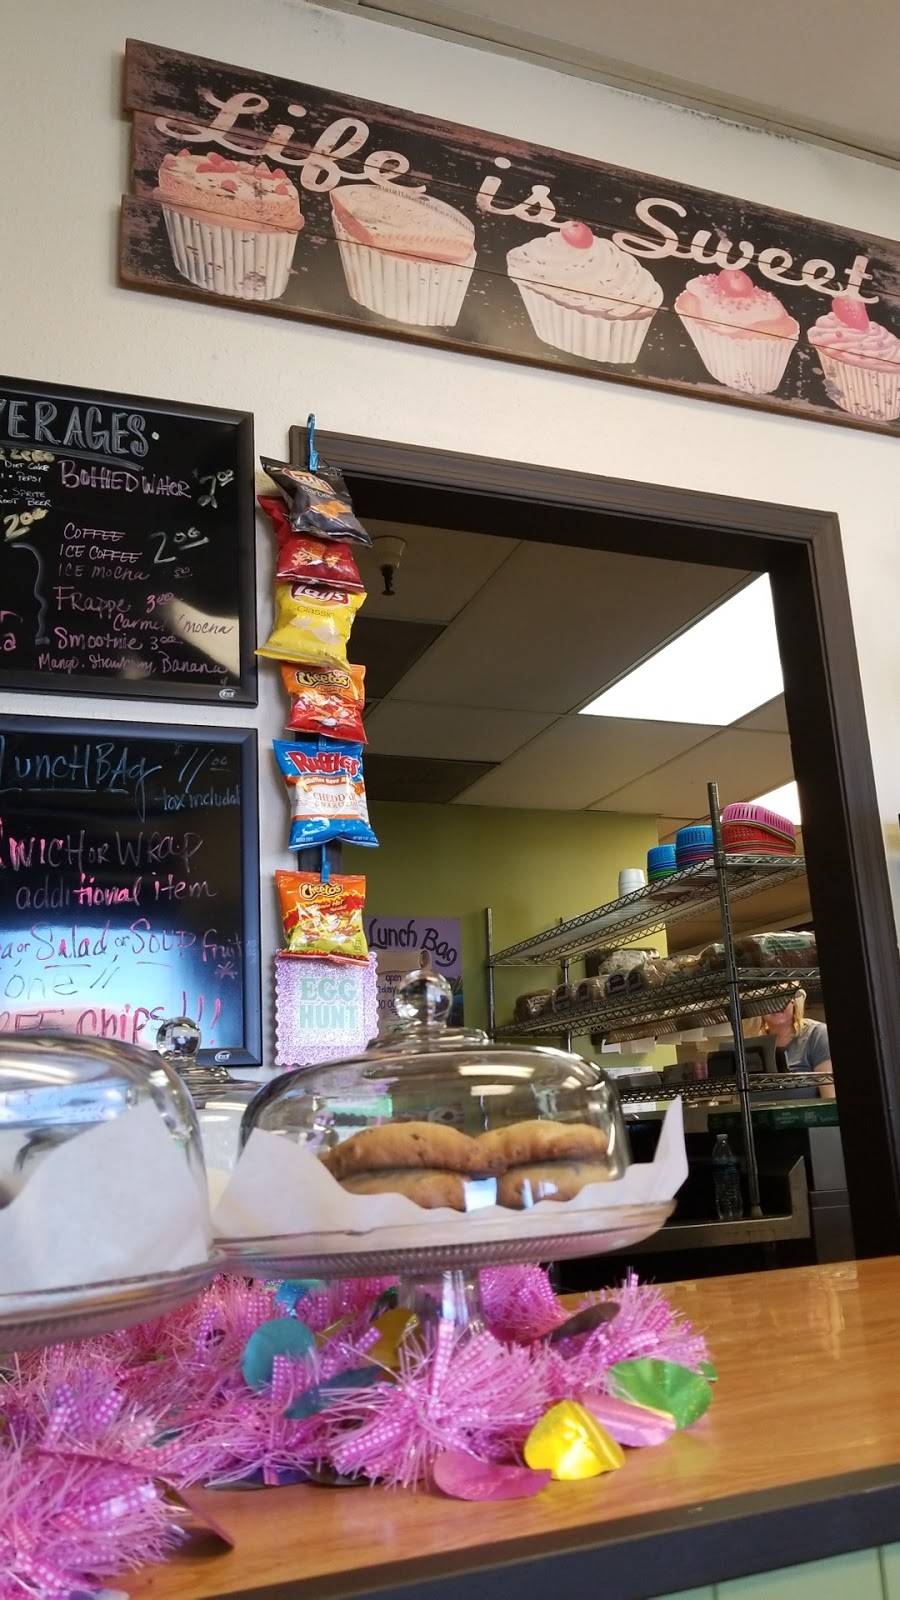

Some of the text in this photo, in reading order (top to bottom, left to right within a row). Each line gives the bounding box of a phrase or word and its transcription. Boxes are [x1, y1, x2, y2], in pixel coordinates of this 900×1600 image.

[155, 92, 880, 304] Life is Sweet
[63, 522, 126, 542] COFFEE
[59, 543, 143, 563] ICE COFFEE
[296, 671, 350, 687] Cheetos
[286, 750, 360, 778] Ruffles
[154, 872, 216, 902] item
[300, 883, 343, 899] Cheetos
[368, 919, 457, 967] Lunch Bag
[299, 976, 357, 1001] EGG
[299, 1002, 358, 1029] HUNT
